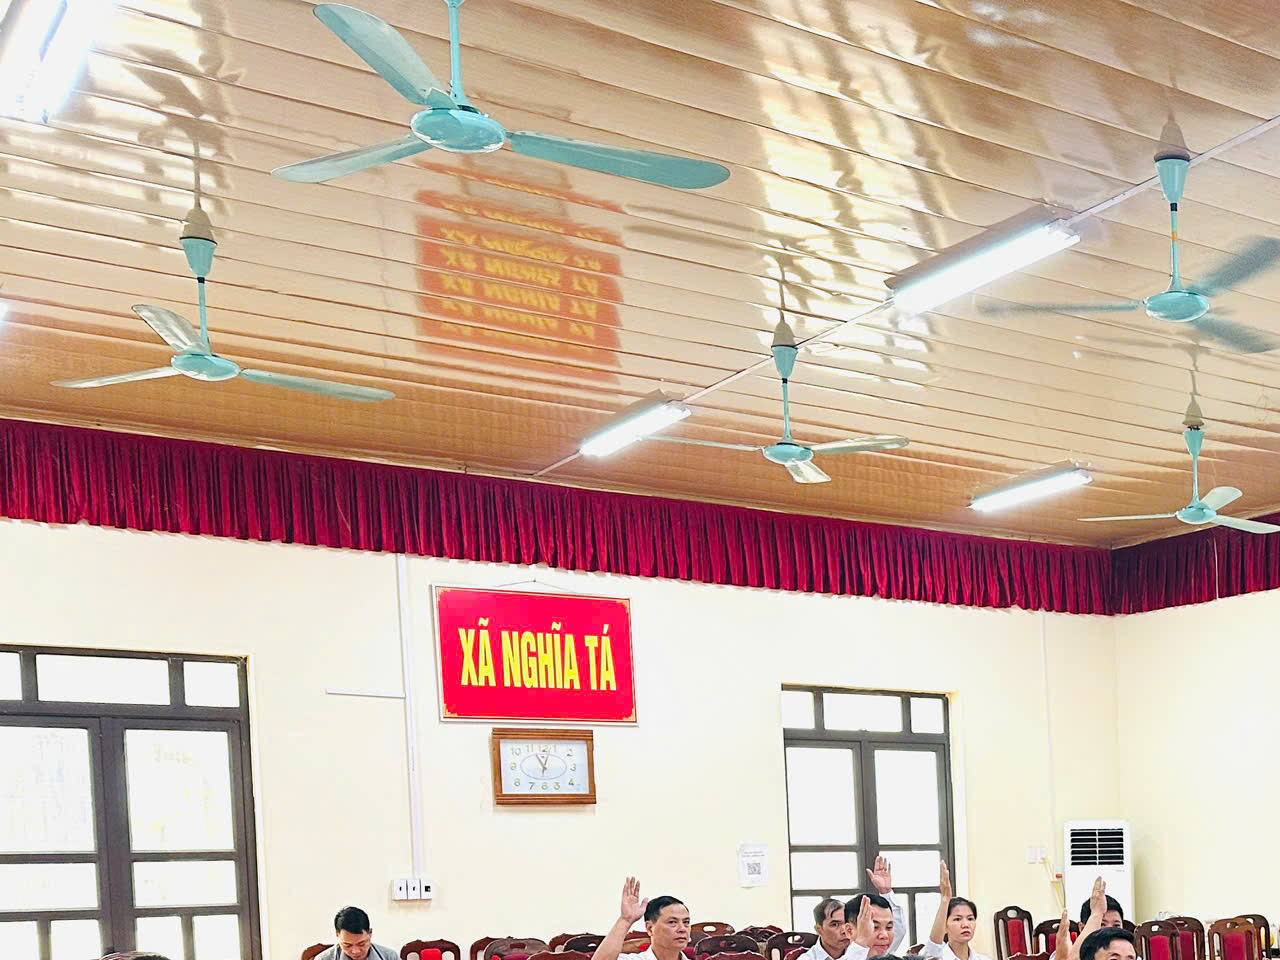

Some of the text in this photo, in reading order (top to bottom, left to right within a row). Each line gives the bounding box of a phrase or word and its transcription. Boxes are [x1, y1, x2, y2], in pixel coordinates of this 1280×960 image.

[458, 617, 617, 691] XÃ NGHĨA TÁ
